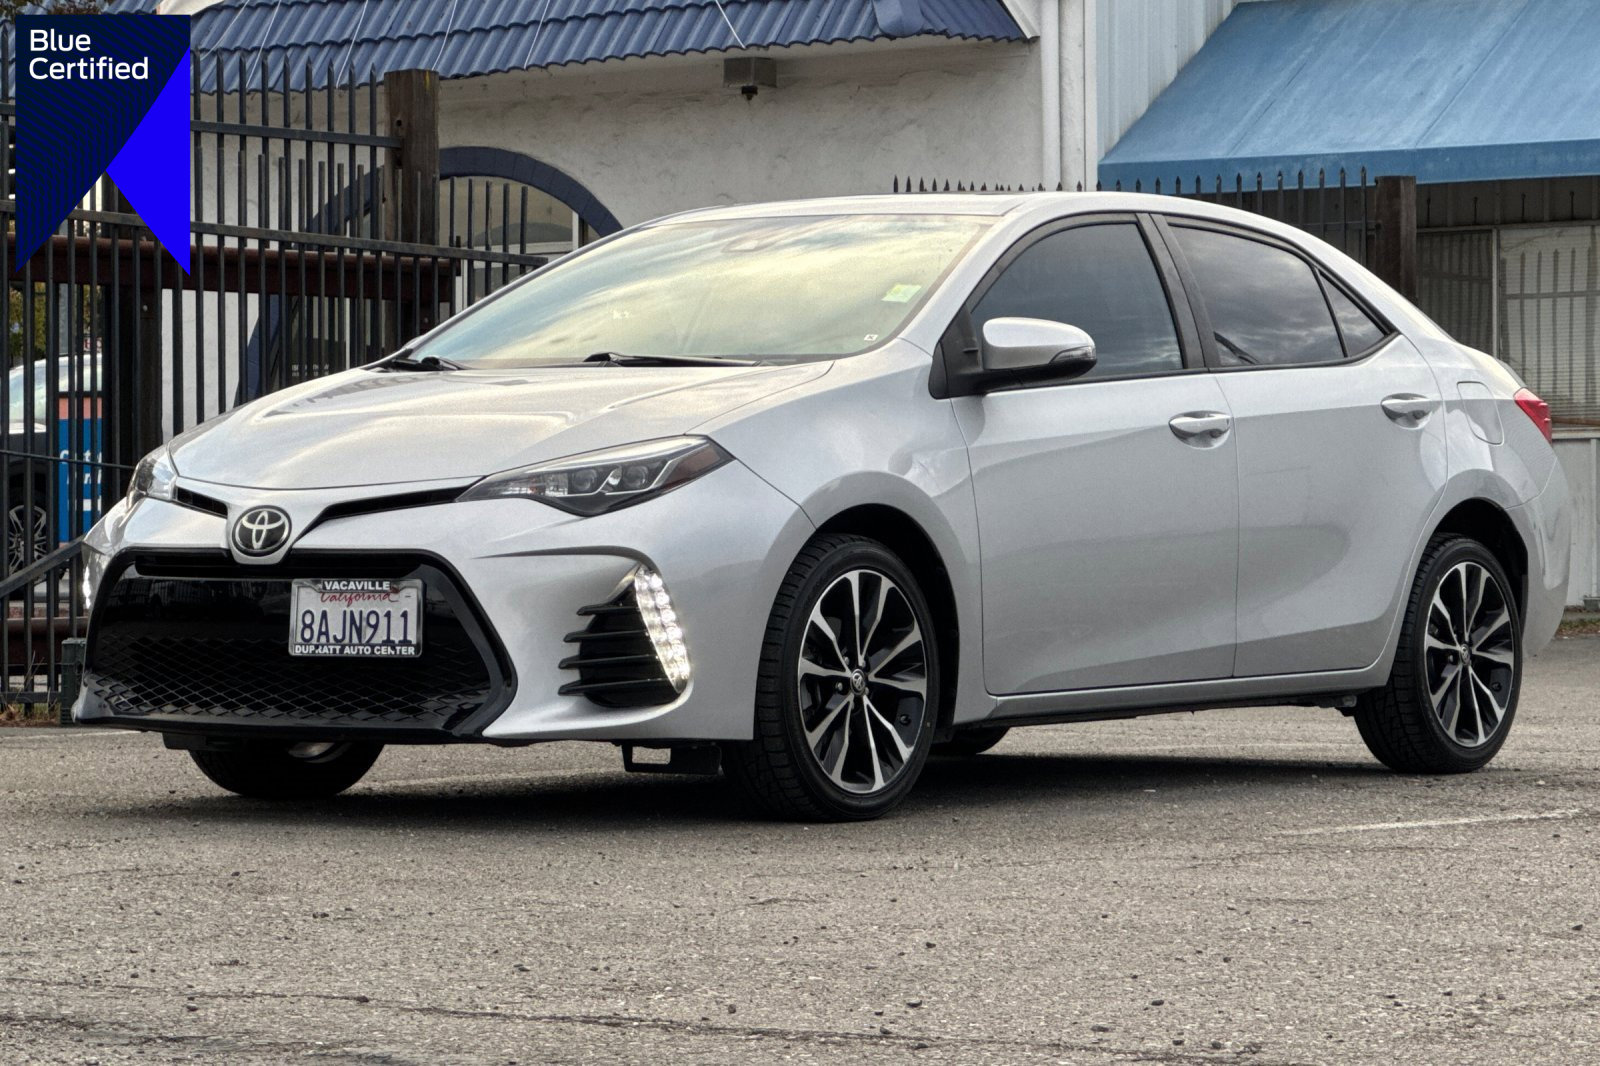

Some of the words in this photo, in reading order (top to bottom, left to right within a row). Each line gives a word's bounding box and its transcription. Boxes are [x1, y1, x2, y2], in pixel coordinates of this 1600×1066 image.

[324, 581, 390, 591] VACAVILLE
[300, 609, 412, 644] 8AJN911
[343, 645, 371, 655] AUTO
